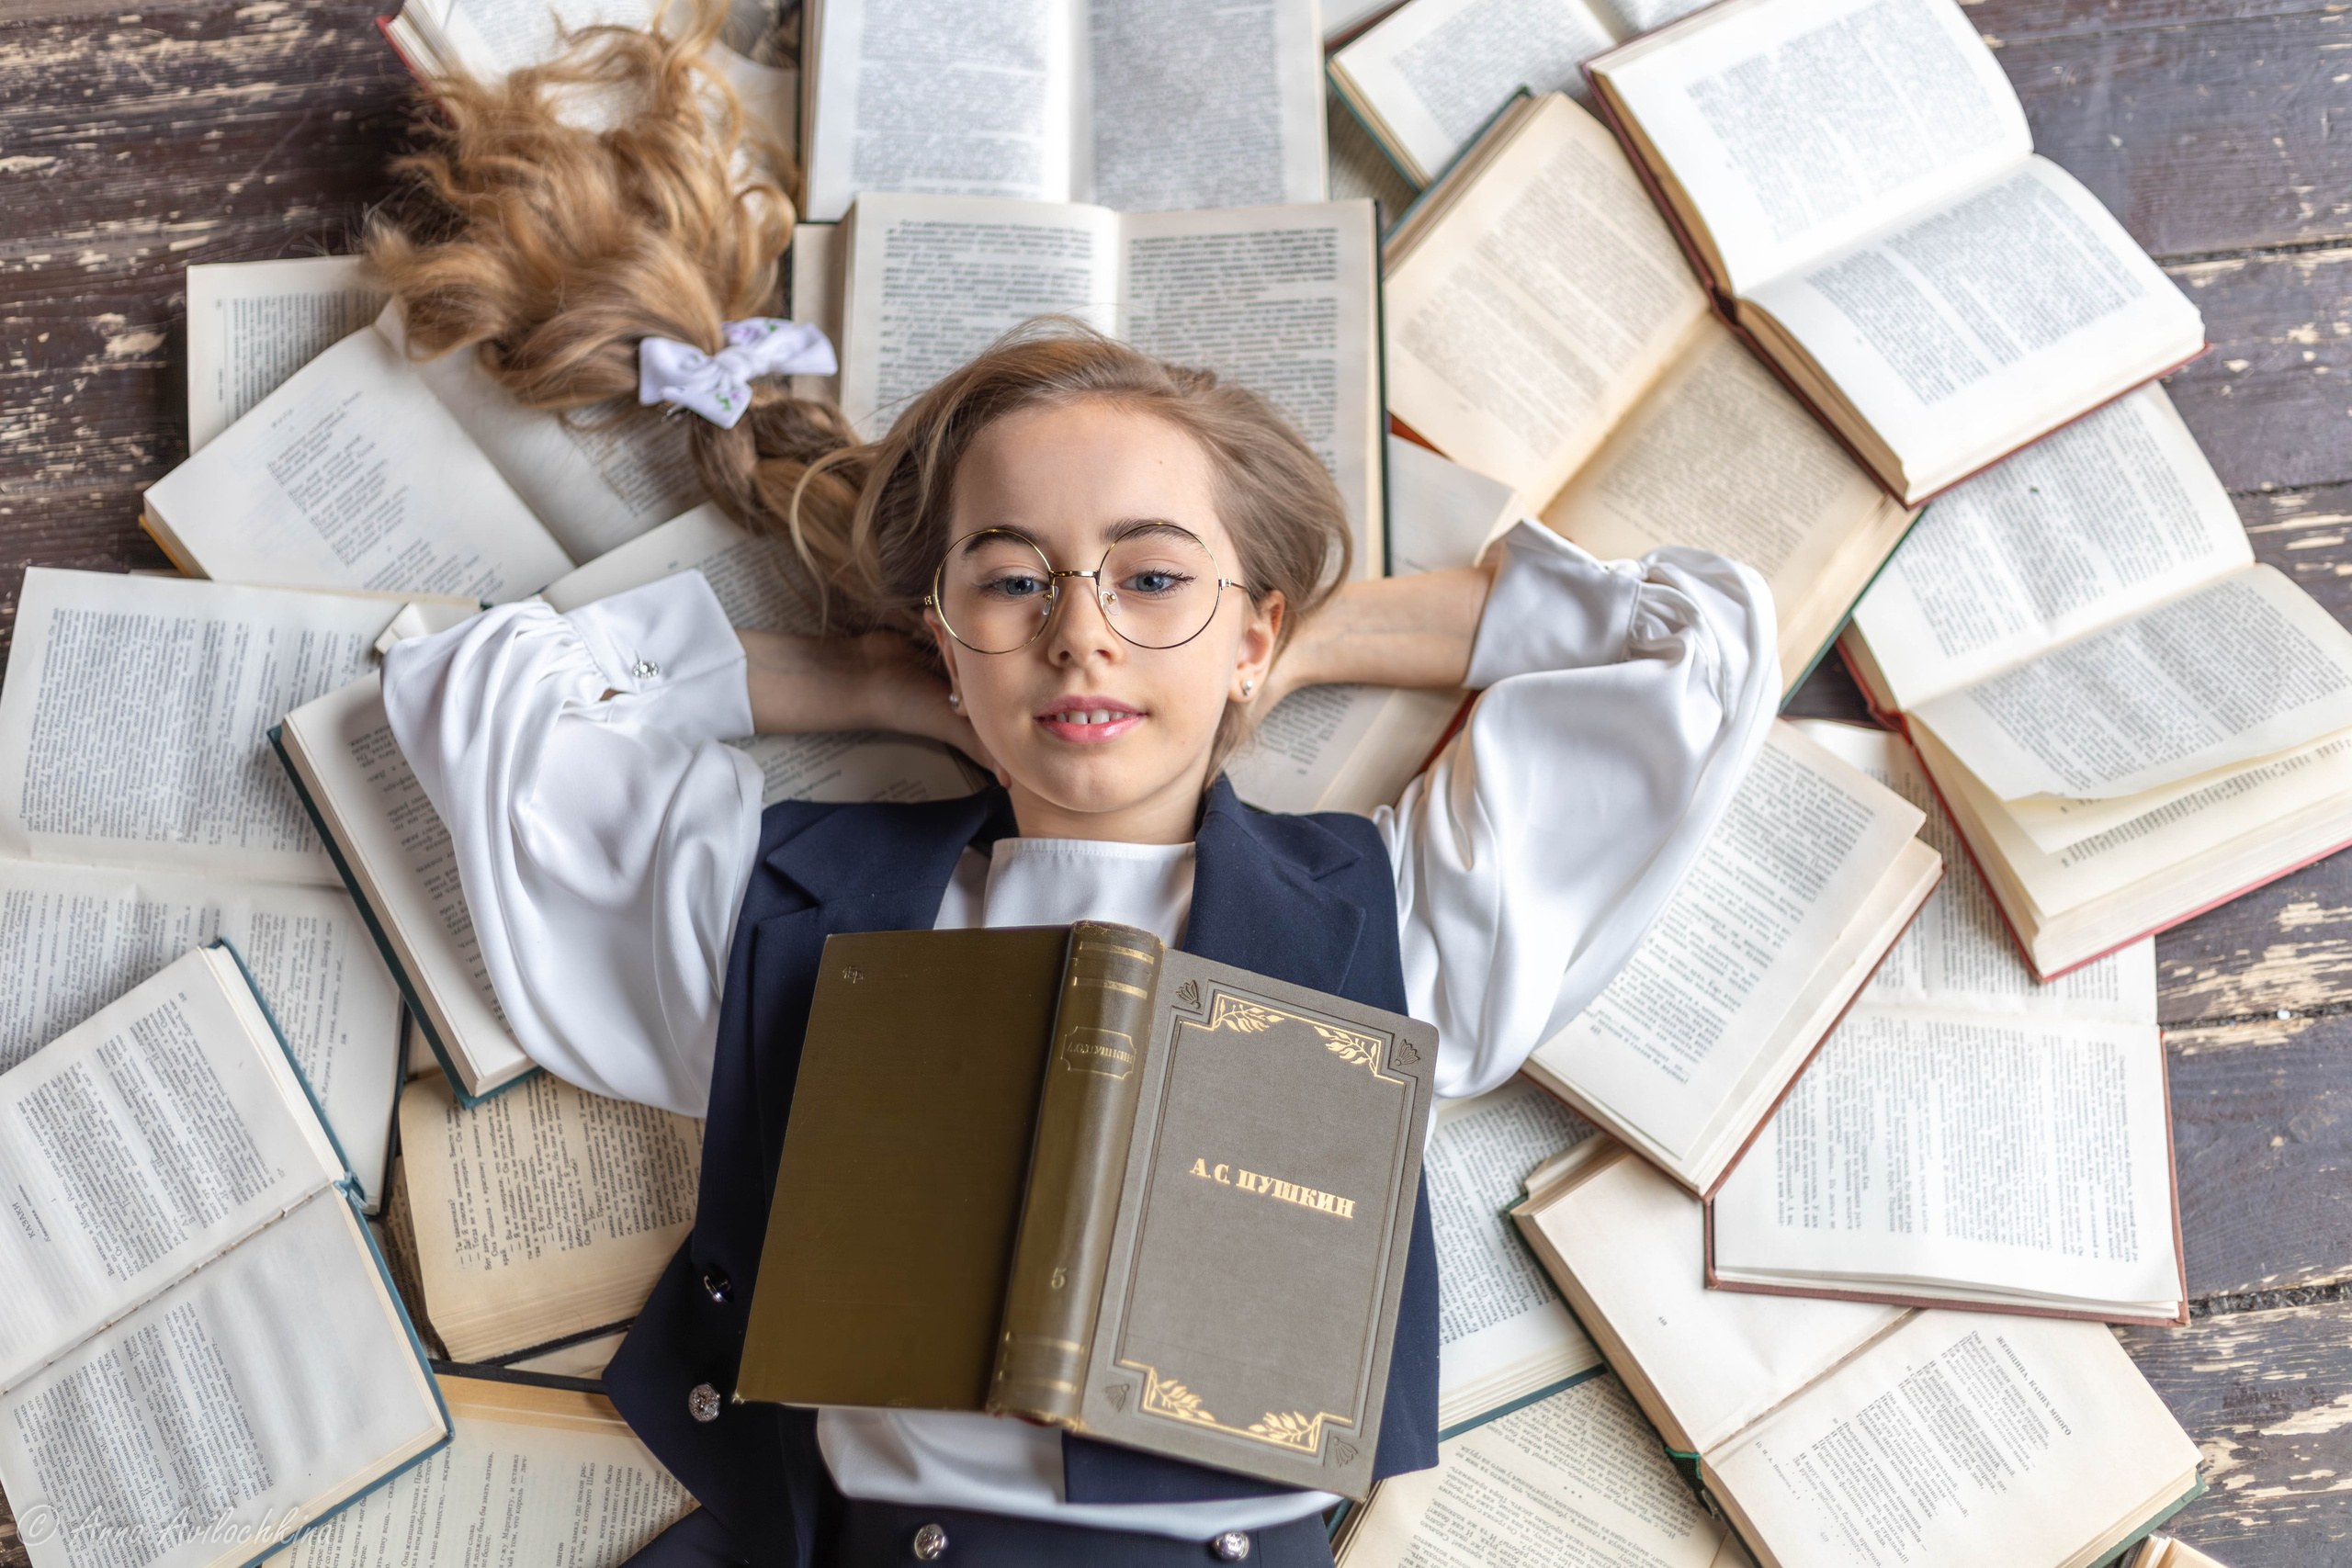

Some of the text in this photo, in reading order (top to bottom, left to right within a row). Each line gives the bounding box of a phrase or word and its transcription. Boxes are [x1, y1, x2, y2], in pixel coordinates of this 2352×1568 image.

[1236, 1168, 1356, 1219] ПУШКИН
[10, 1201, 36, 1239] КАЗАКИ
[177, 1304, 190, 1327] начало
[176, 1325, 188, 1342] новое
[173, 1337, 187, 1359] старое
[181, 1359, 197, 1384] мужем;
[187, 1349, 212, 1400] воспоминанием,
[198, 1361, 212, 1380] детей
[185, 1300, 268, 1493] другой, но уже совершенно иначе счастливой жизни, кото-
[208, 1381, 219, 1397] моих
[220, 1366, 241, 1403] настоящую
[1993, 1334, 2073, 1437] ЖЕНЩИНА, КАКИХ МНОГО
[193, 1389, 208, 1410] роман
[215, 1398, 228, 1416] отцу
[89, 1416, 102, 1432] мой,
[200, 1411, 211, 1425] мой
[208, 1400, 233, 1450] невозвратимым
[238, 1410, 255, 1440] прожила
[208, 1425, 223, 1455] кончился
[228, 1429, 241, 1450] детям
[250, 1441, 258, 1450] не
[220, 1455, 230, 1468] дня
[228, 1450, 245, 1481] дорогим,
[237, 1458, 252, 1481] любви
[254, 1451, 266, 1465] еще
[509, 1453, 519, 1483] оставил
[263, 1472, 275, 1487] рую
[584, 1461, 595, 1484] Шико
[614, 1465, 625, 1491] пером.
[231, 1487, 240, 1495] С
[240, 1482, 252, 1501] стало
[248, 1481, 259, 1496] ство
[422, 1484, 430, 1493] и,
[509, 1530, 518, 1548] том,
[514, 1487, 526, 1514] король
[520, 1454, 528, 1472] лич-
[598, 1463, 613, 1539] всегда можно было
[629, 1467, 645, 1526] на вещах, при-
[413, 1494, 429, 1534] разберется
[429, 1446, 454, 1560] ваше величество, вскричал
[472, 1450, 495, 1562] должен был бы знать латынь,
[571, 1461, 589, 1544] замка, где покои рас-
[582, 1488, 594, 1522] которого
[609, 1498, 618, 1522] шляпе
[617, 1466, 633, 1541] под самыми окнами
[399, 1483, 422, 1567] Она женщина ученая.
[499, 1495, 515, 1540] Маргариту,
[580, 1525, 587, 1534] из
[351, 1530, 361, 1557] советы
[378, 1510, 392, 1554] одну вещь,
[413, 1536, 421, 1550] нем
[605, 1529, 616, 1561] кавалер
[499, 1543, 509, 1561] г-жу
[555, 1540, 564, 1566] шагов
[577, 1538, 586, 1554] том,
